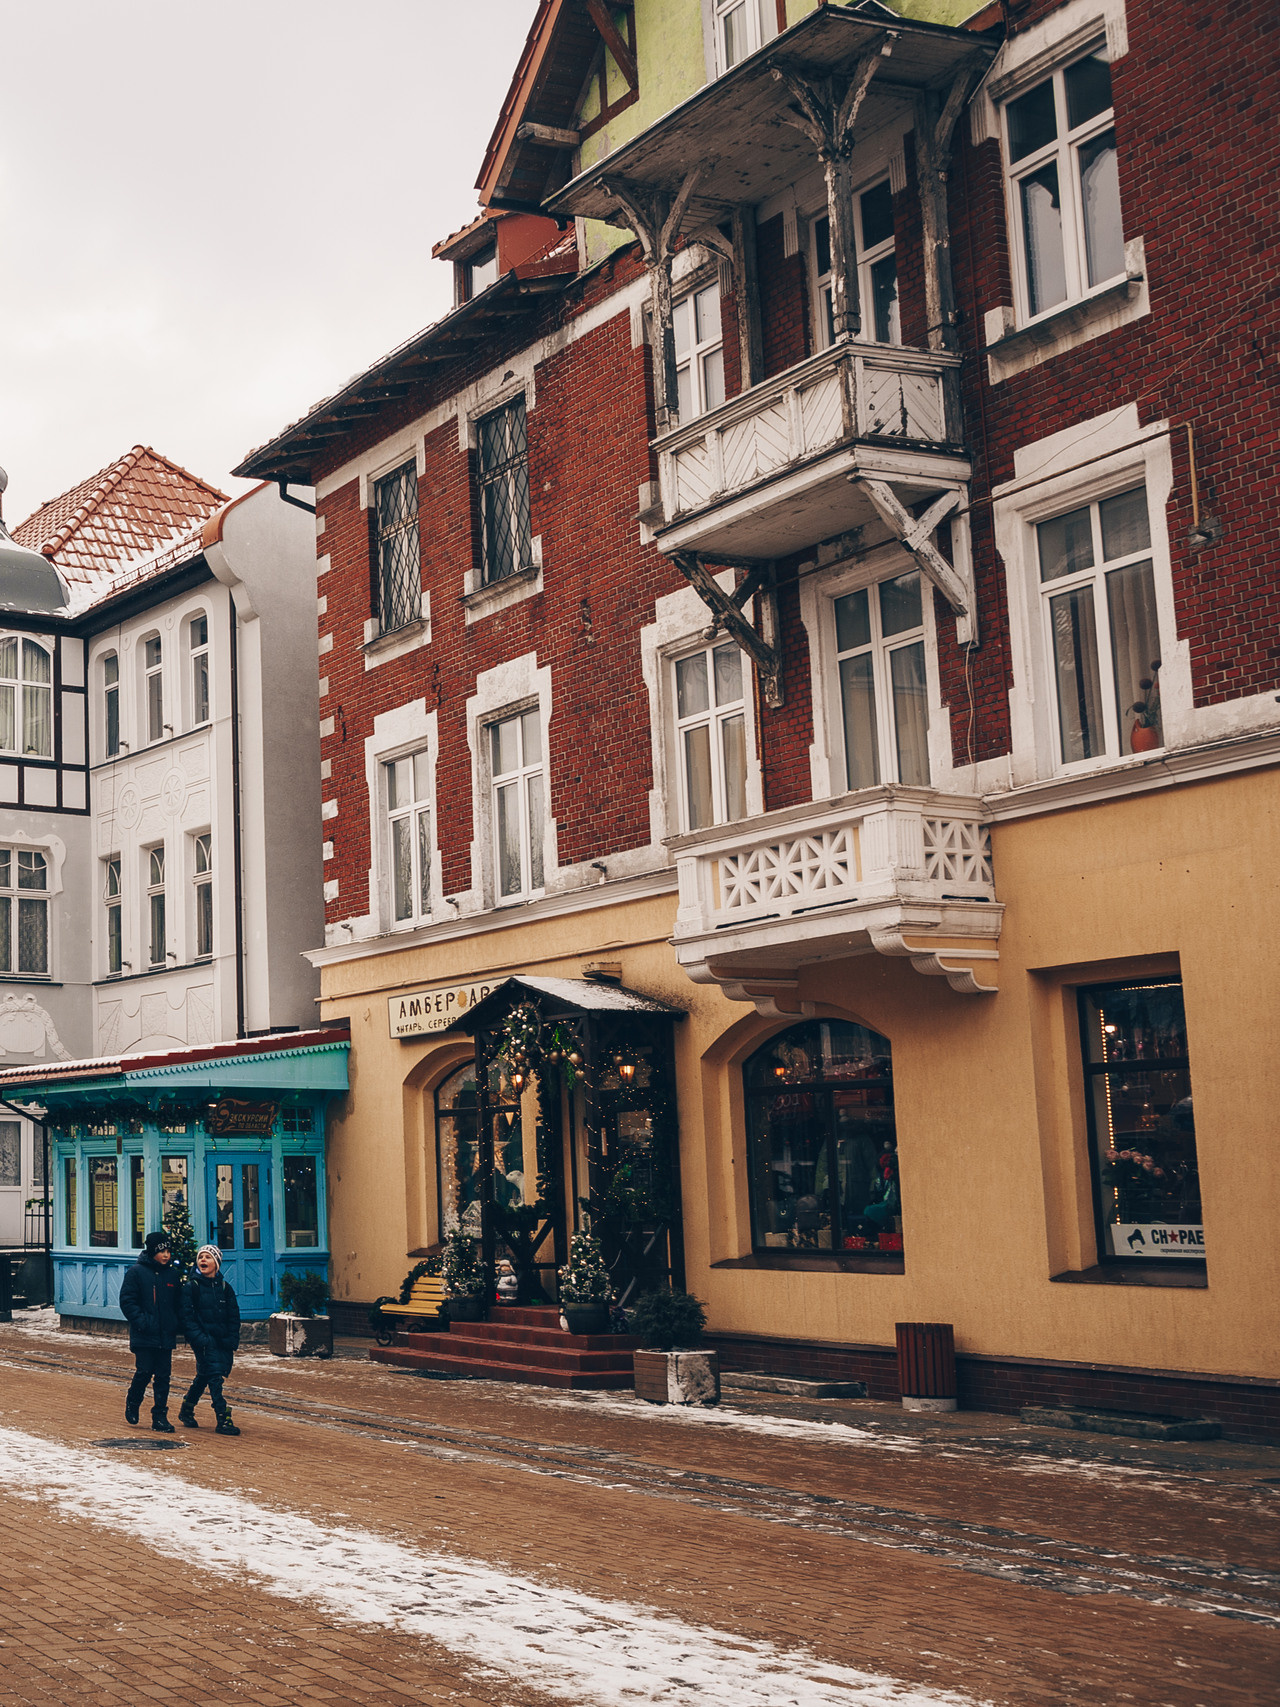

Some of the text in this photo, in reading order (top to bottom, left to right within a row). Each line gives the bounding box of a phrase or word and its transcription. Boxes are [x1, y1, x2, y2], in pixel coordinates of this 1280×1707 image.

[399, 983, 502, 1019] АМБЕР АР
[428, 1016, 460, 1029] СЕРЕБР
